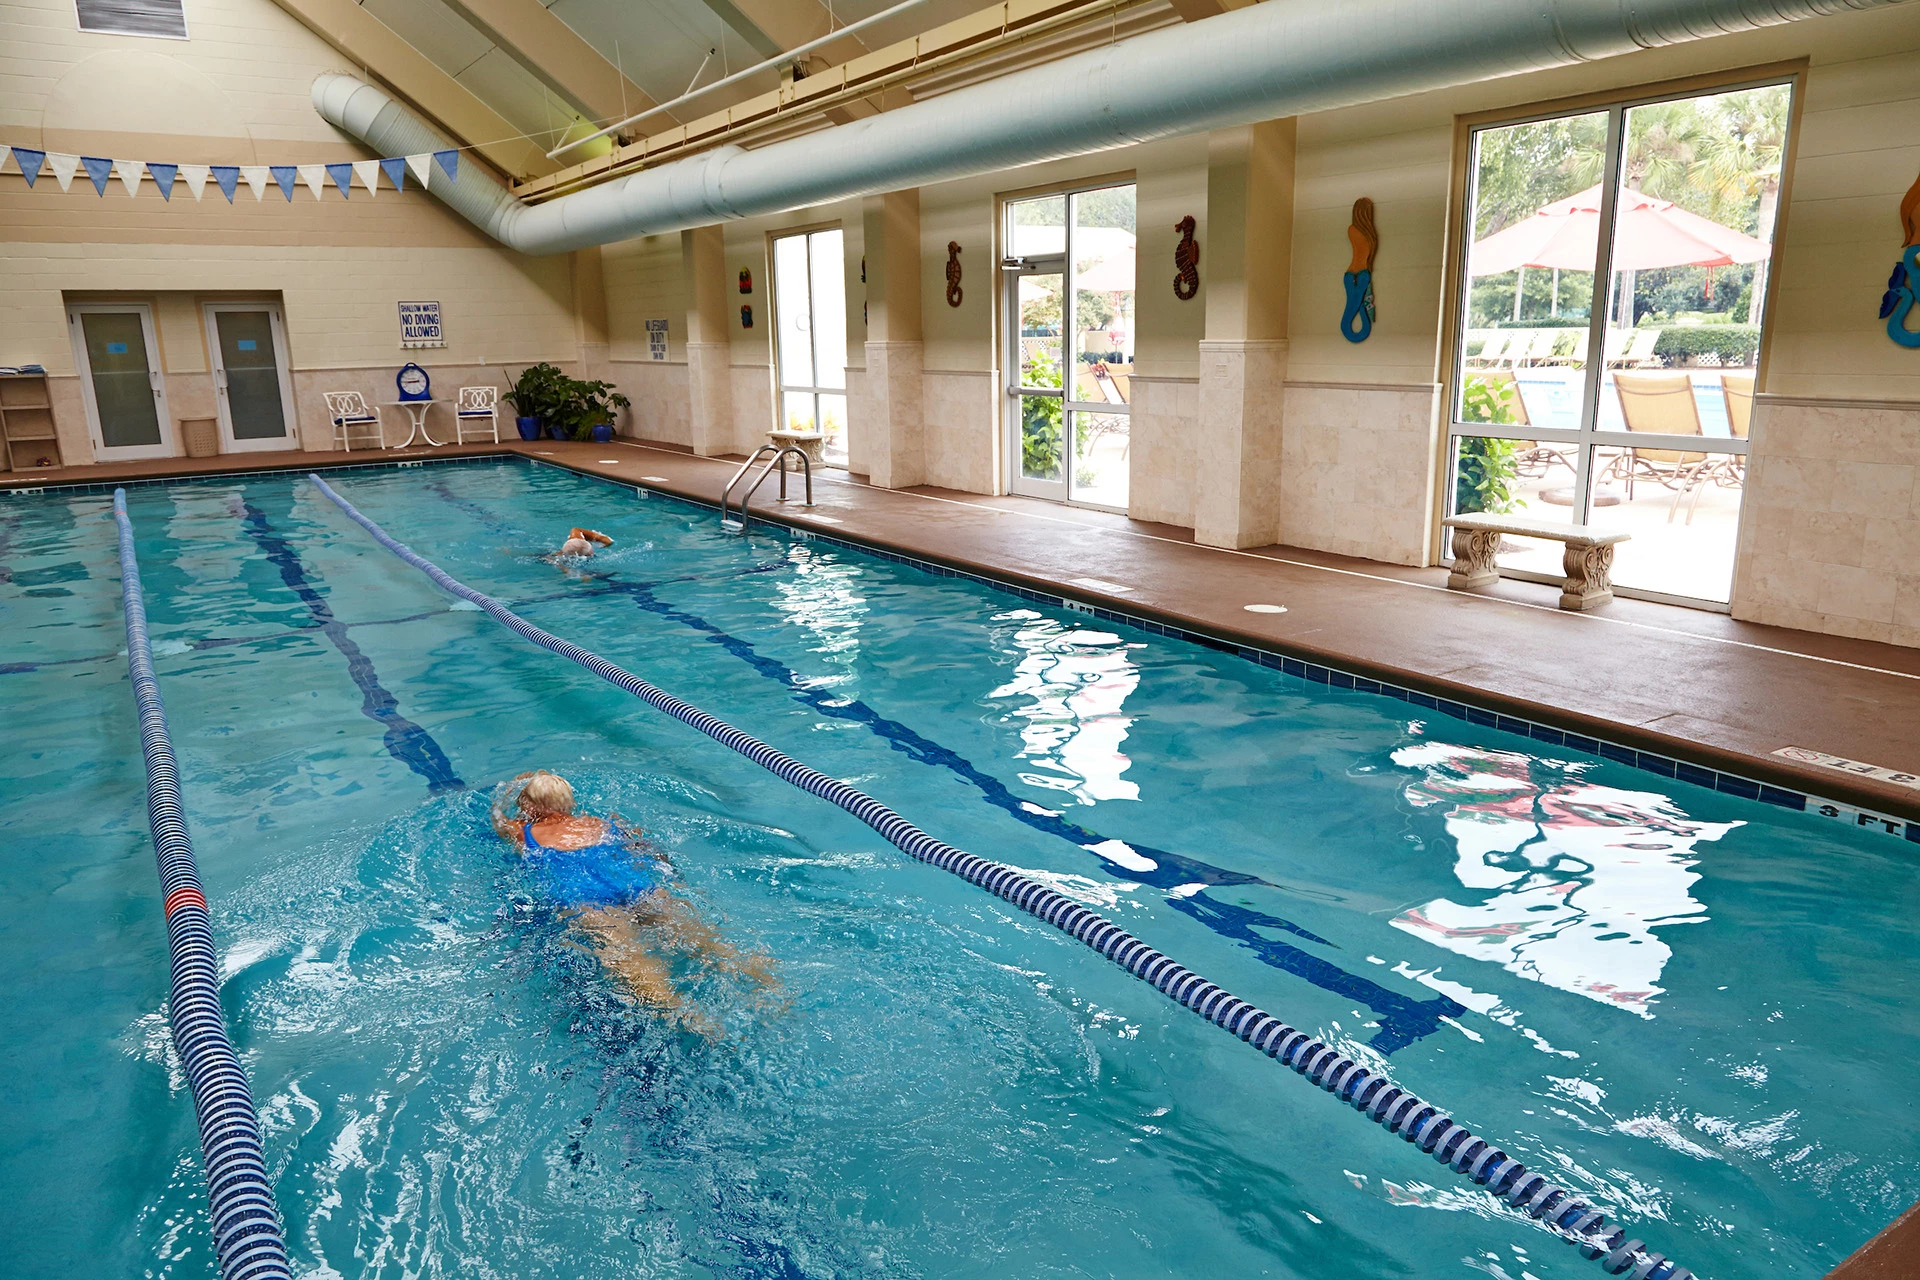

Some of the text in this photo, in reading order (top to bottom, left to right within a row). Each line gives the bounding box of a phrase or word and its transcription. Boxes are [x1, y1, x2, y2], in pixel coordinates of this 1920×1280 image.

[423, 304, 437, 312] WATER
[401, 314, 439, 325] NO DIVING
[405, 326, 439, 337] ALLOWED
